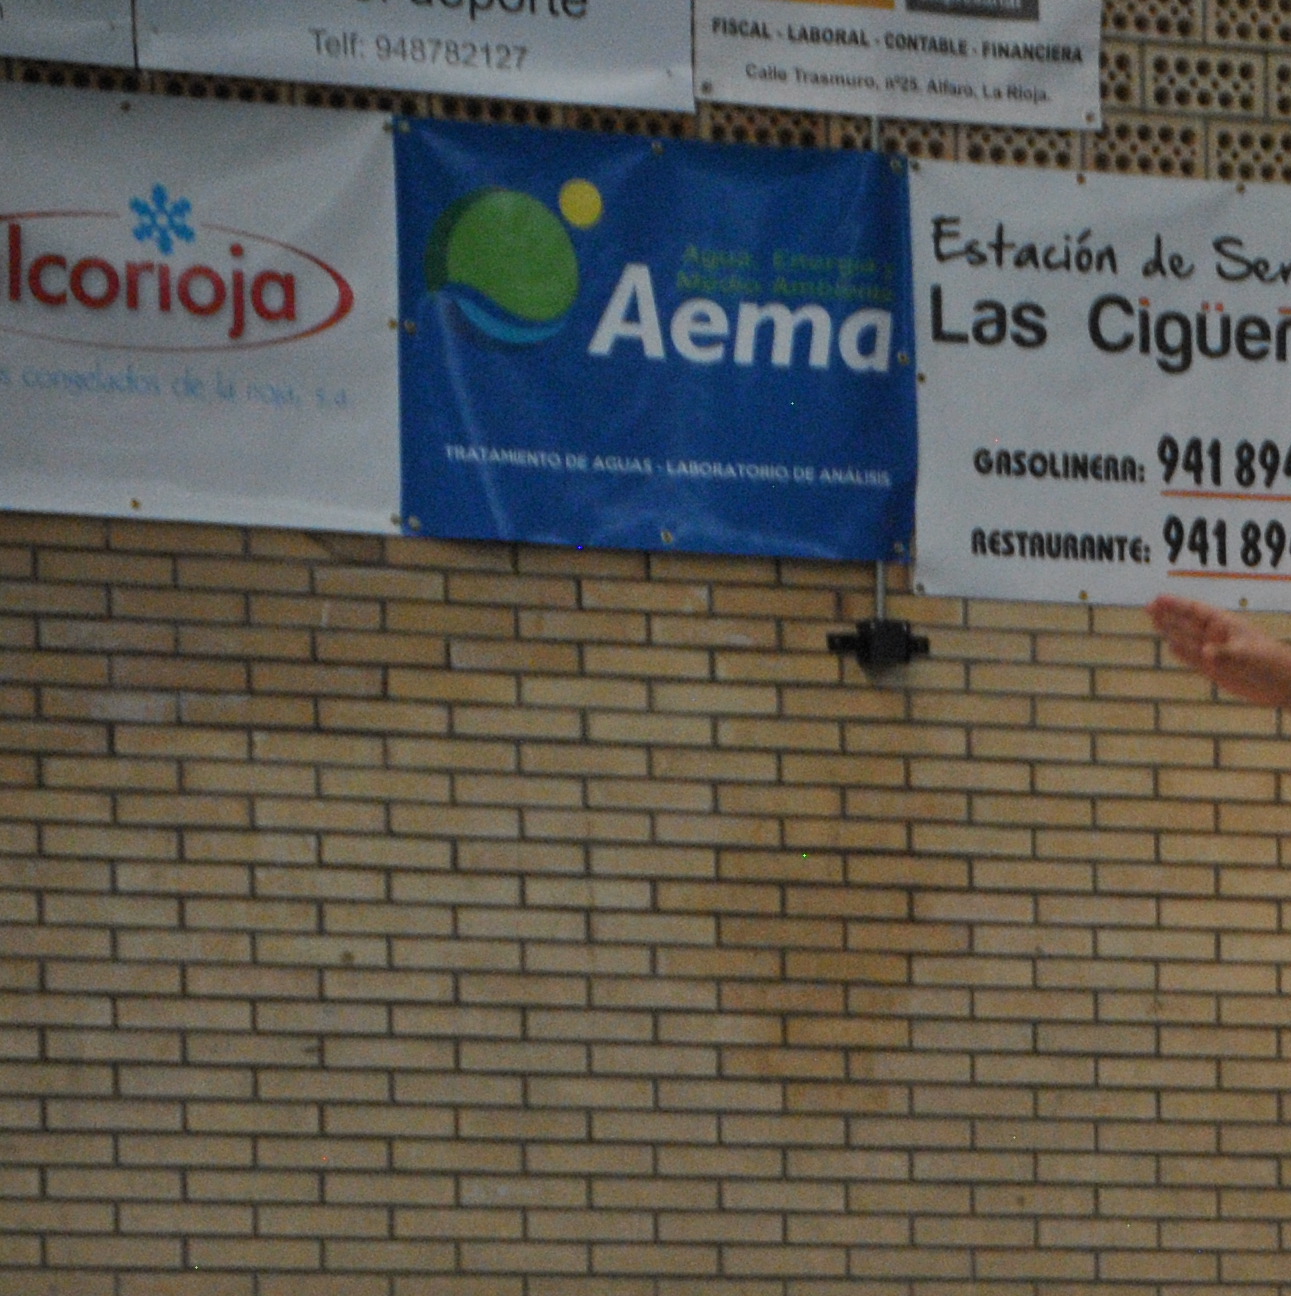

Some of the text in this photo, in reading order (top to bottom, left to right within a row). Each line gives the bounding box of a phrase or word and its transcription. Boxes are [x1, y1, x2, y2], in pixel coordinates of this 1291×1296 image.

[309, 28, 529, 70] Telf: 948782127
[712, 16, 1083, 62] FISCAL LABORAL CONTABLE FINANCIERA
[745, 62, 788, 81] Calle
[983, 84, 1003, 99] La
[931, 215, 1118, 275] Estación
[1142, 233, 1194, 279] de
[587, 262, 893, 373] Aema
[930, 283, 1048, 348] Las
[446, 445, 561, 468] TRATAMIENTO
[565, 453, 588, 470] DE
[592, 455, 652, 473] AGUAS
[666, 459, 789, 480] LABORATORIO
[793, 466, 814, 481] DE
[973, 447, 1146, 483] GASOLINERA:
[1157, 433, 1222, 487] 941
[971, 526, 1151, 564] RESTAURANTE:
[1162, 513, 1227, 567] 941
